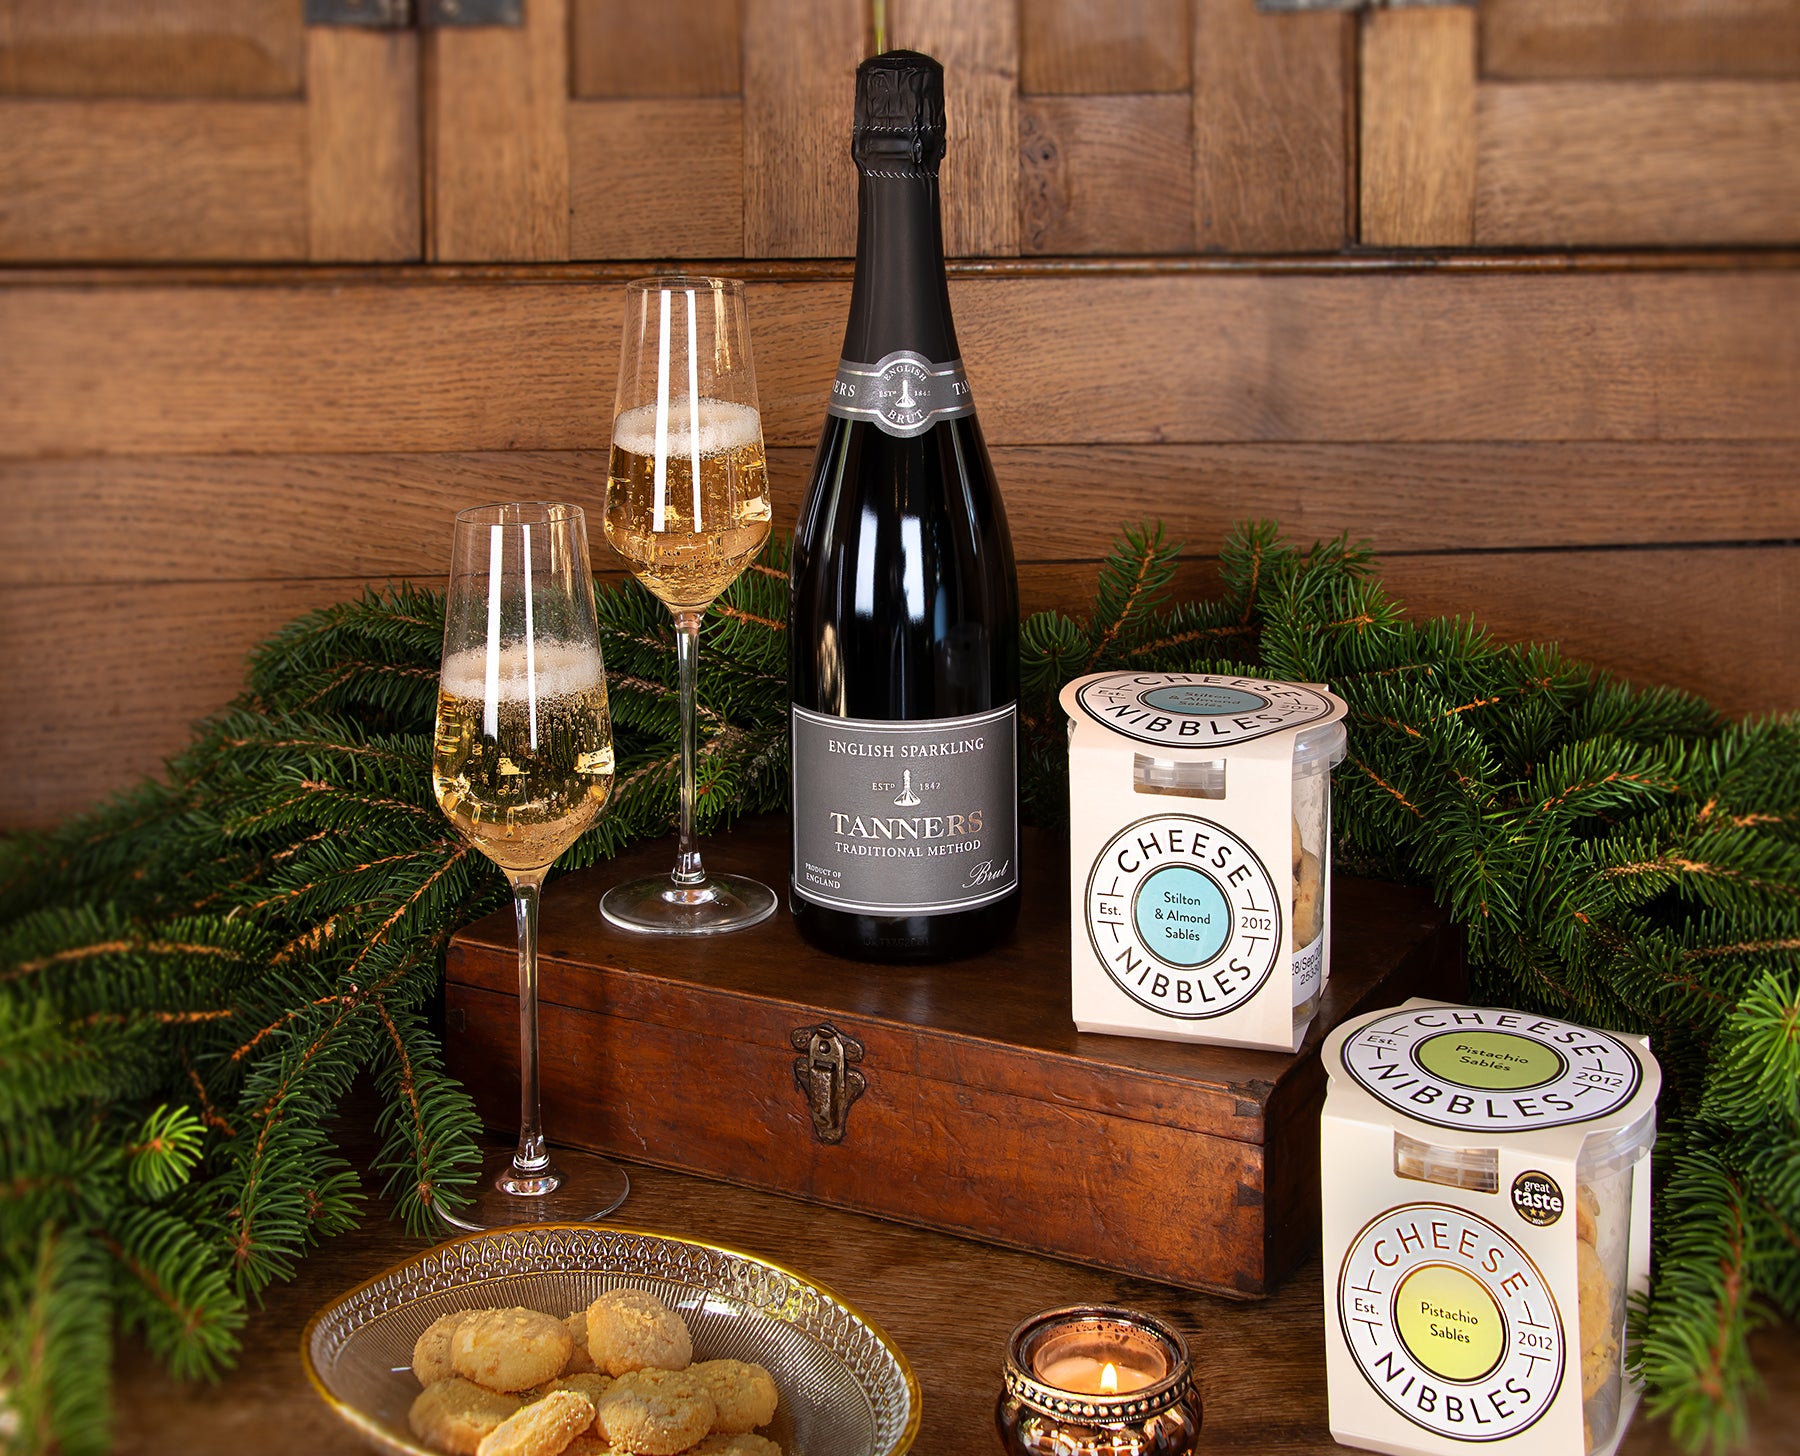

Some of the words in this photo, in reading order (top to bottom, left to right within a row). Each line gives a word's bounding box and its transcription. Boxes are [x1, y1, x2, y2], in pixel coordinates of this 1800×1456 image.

[884, 365, 927, 382] ENGLISH
[833, 379, 856, 397] ERS
[887, 409, 924, 424] BRUT
[1133, 674, 1303, 699] CHEESE
[1185, 691, 1231, 699] Stilton
[1183, 697, 1241, 705] Almond
[1105, 704, 1285, 737] NIBBLES
[828, 739, 895, 758] ENGLISH
[900, 737, 985, 758] SPARKLING
[829, 810, 984, 840] TANNERS
[835, 841, 923, 858] TRADITIONAL
[927, 839, 982, 857] METHOD
[1117, 829, 1253, 888] CHEESE
[805, 862, 831, 876] PRODUCT
[832, 870, 842, 879] OF
[962, 859, 1009, 889] Brut
[806, 872, 841, 889] ENGLAND
[1163, 891, 1201, 907] Stilton
[1099, 902, 1122, 917] Est.
[1154, 908, 1164, 920] &
[1166, 909, 1211, 926] Almond
[1241, 916, 1272, 932] 2012
[1165, 926, 1201, 942] Sablés
[1115, 945, 1252, 1004] NIBBLES
[1367, 1034, 1398, 1047] Est.
[1413, 1012, 1611, 1058] CHEESE
[1455, 1044, 1530, 1066] Pistachio
[1458, 1055, 1512, 1072] Sablés
[1575, 1071, 1624, 1088] 2012
[1367, 1063, 1576, 1119] NIBBLES
[1524, 1180, 1550, 1194] great
[1513, 1188, 1563, 1213] taste
[1373, 1221, 1530, 1298] CHEESE
[1354, 1298, 1380, 1316] Est.
[1420, 1301, 1479, 1326] Pistachio
[1429, 1323, 1471, 1345] Sablés
[1518, 1331, 1554, 1351] 2012
[1373, 1351, 1532, 1425] NIBBLES
